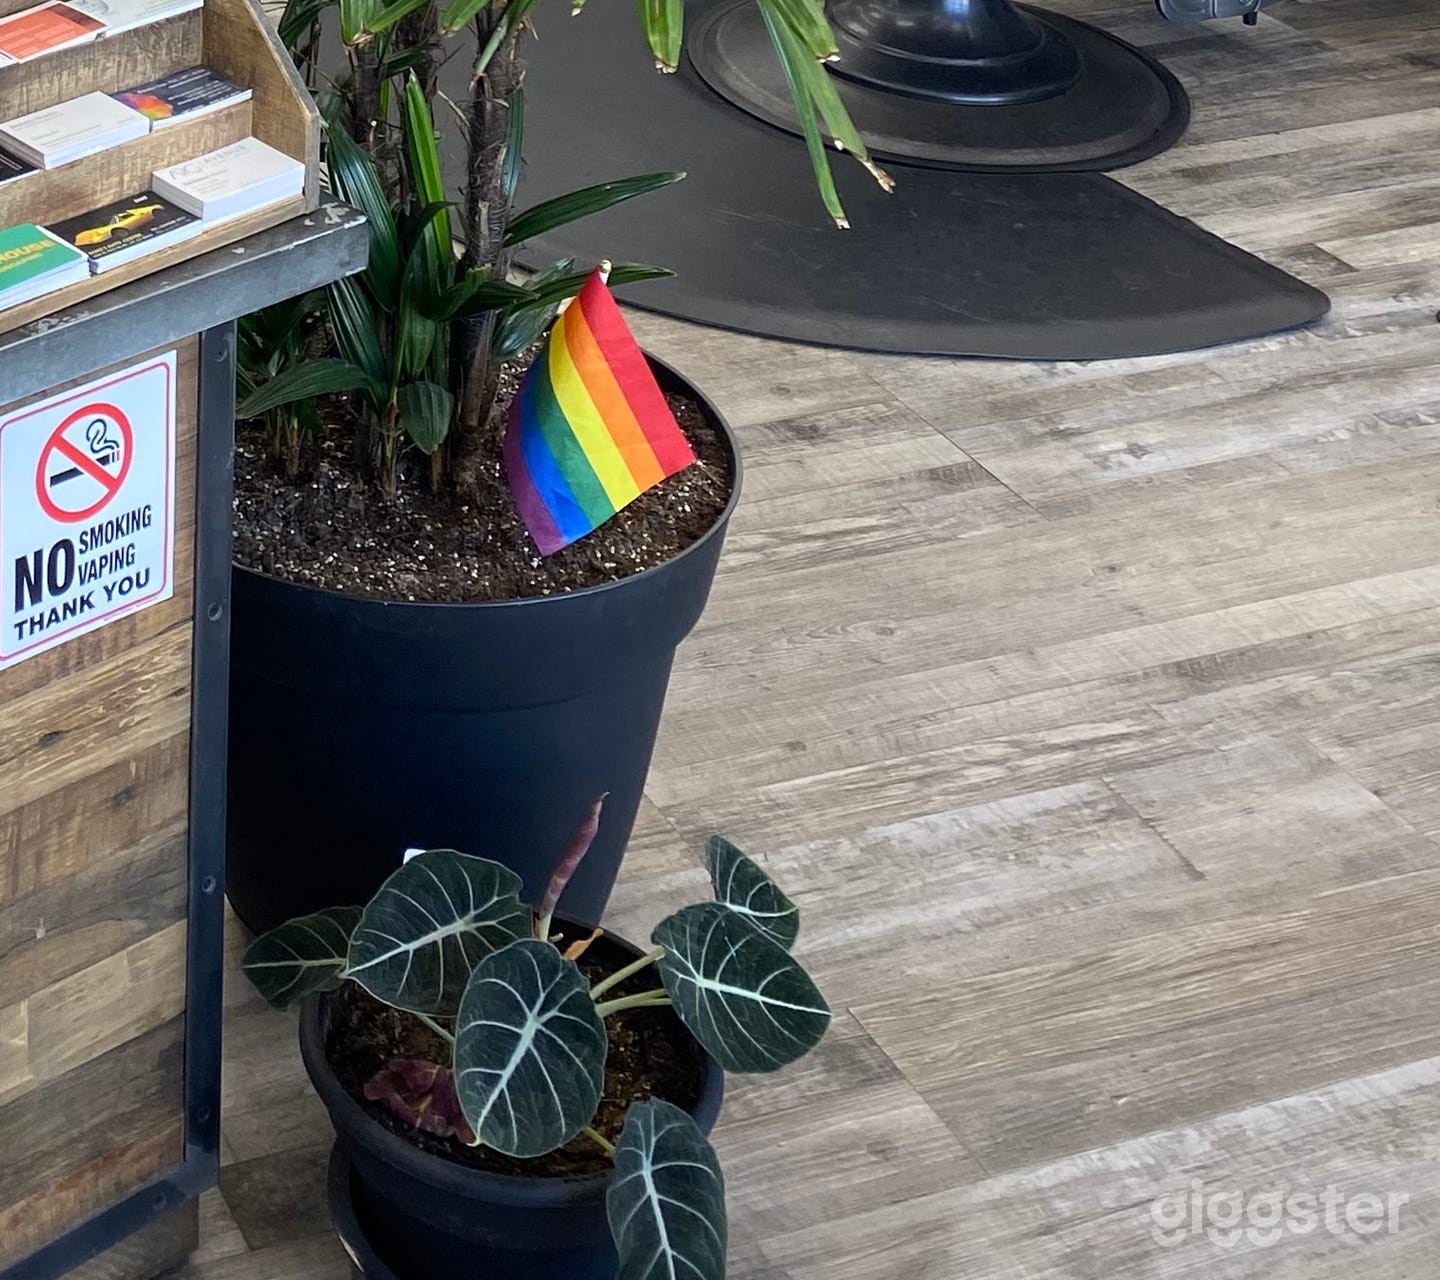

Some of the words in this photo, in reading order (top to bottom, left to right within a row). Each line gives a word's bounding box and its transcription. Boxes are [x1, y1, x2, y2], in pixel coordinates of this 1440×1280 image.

[14, 537, 76, 615] NO
[78, 504, 152, 555] SMOKING
[78, 542, 136, 586] VAPING
[14, 592, 95, 641] THANK
[103, 567, 151, 603] YOU
